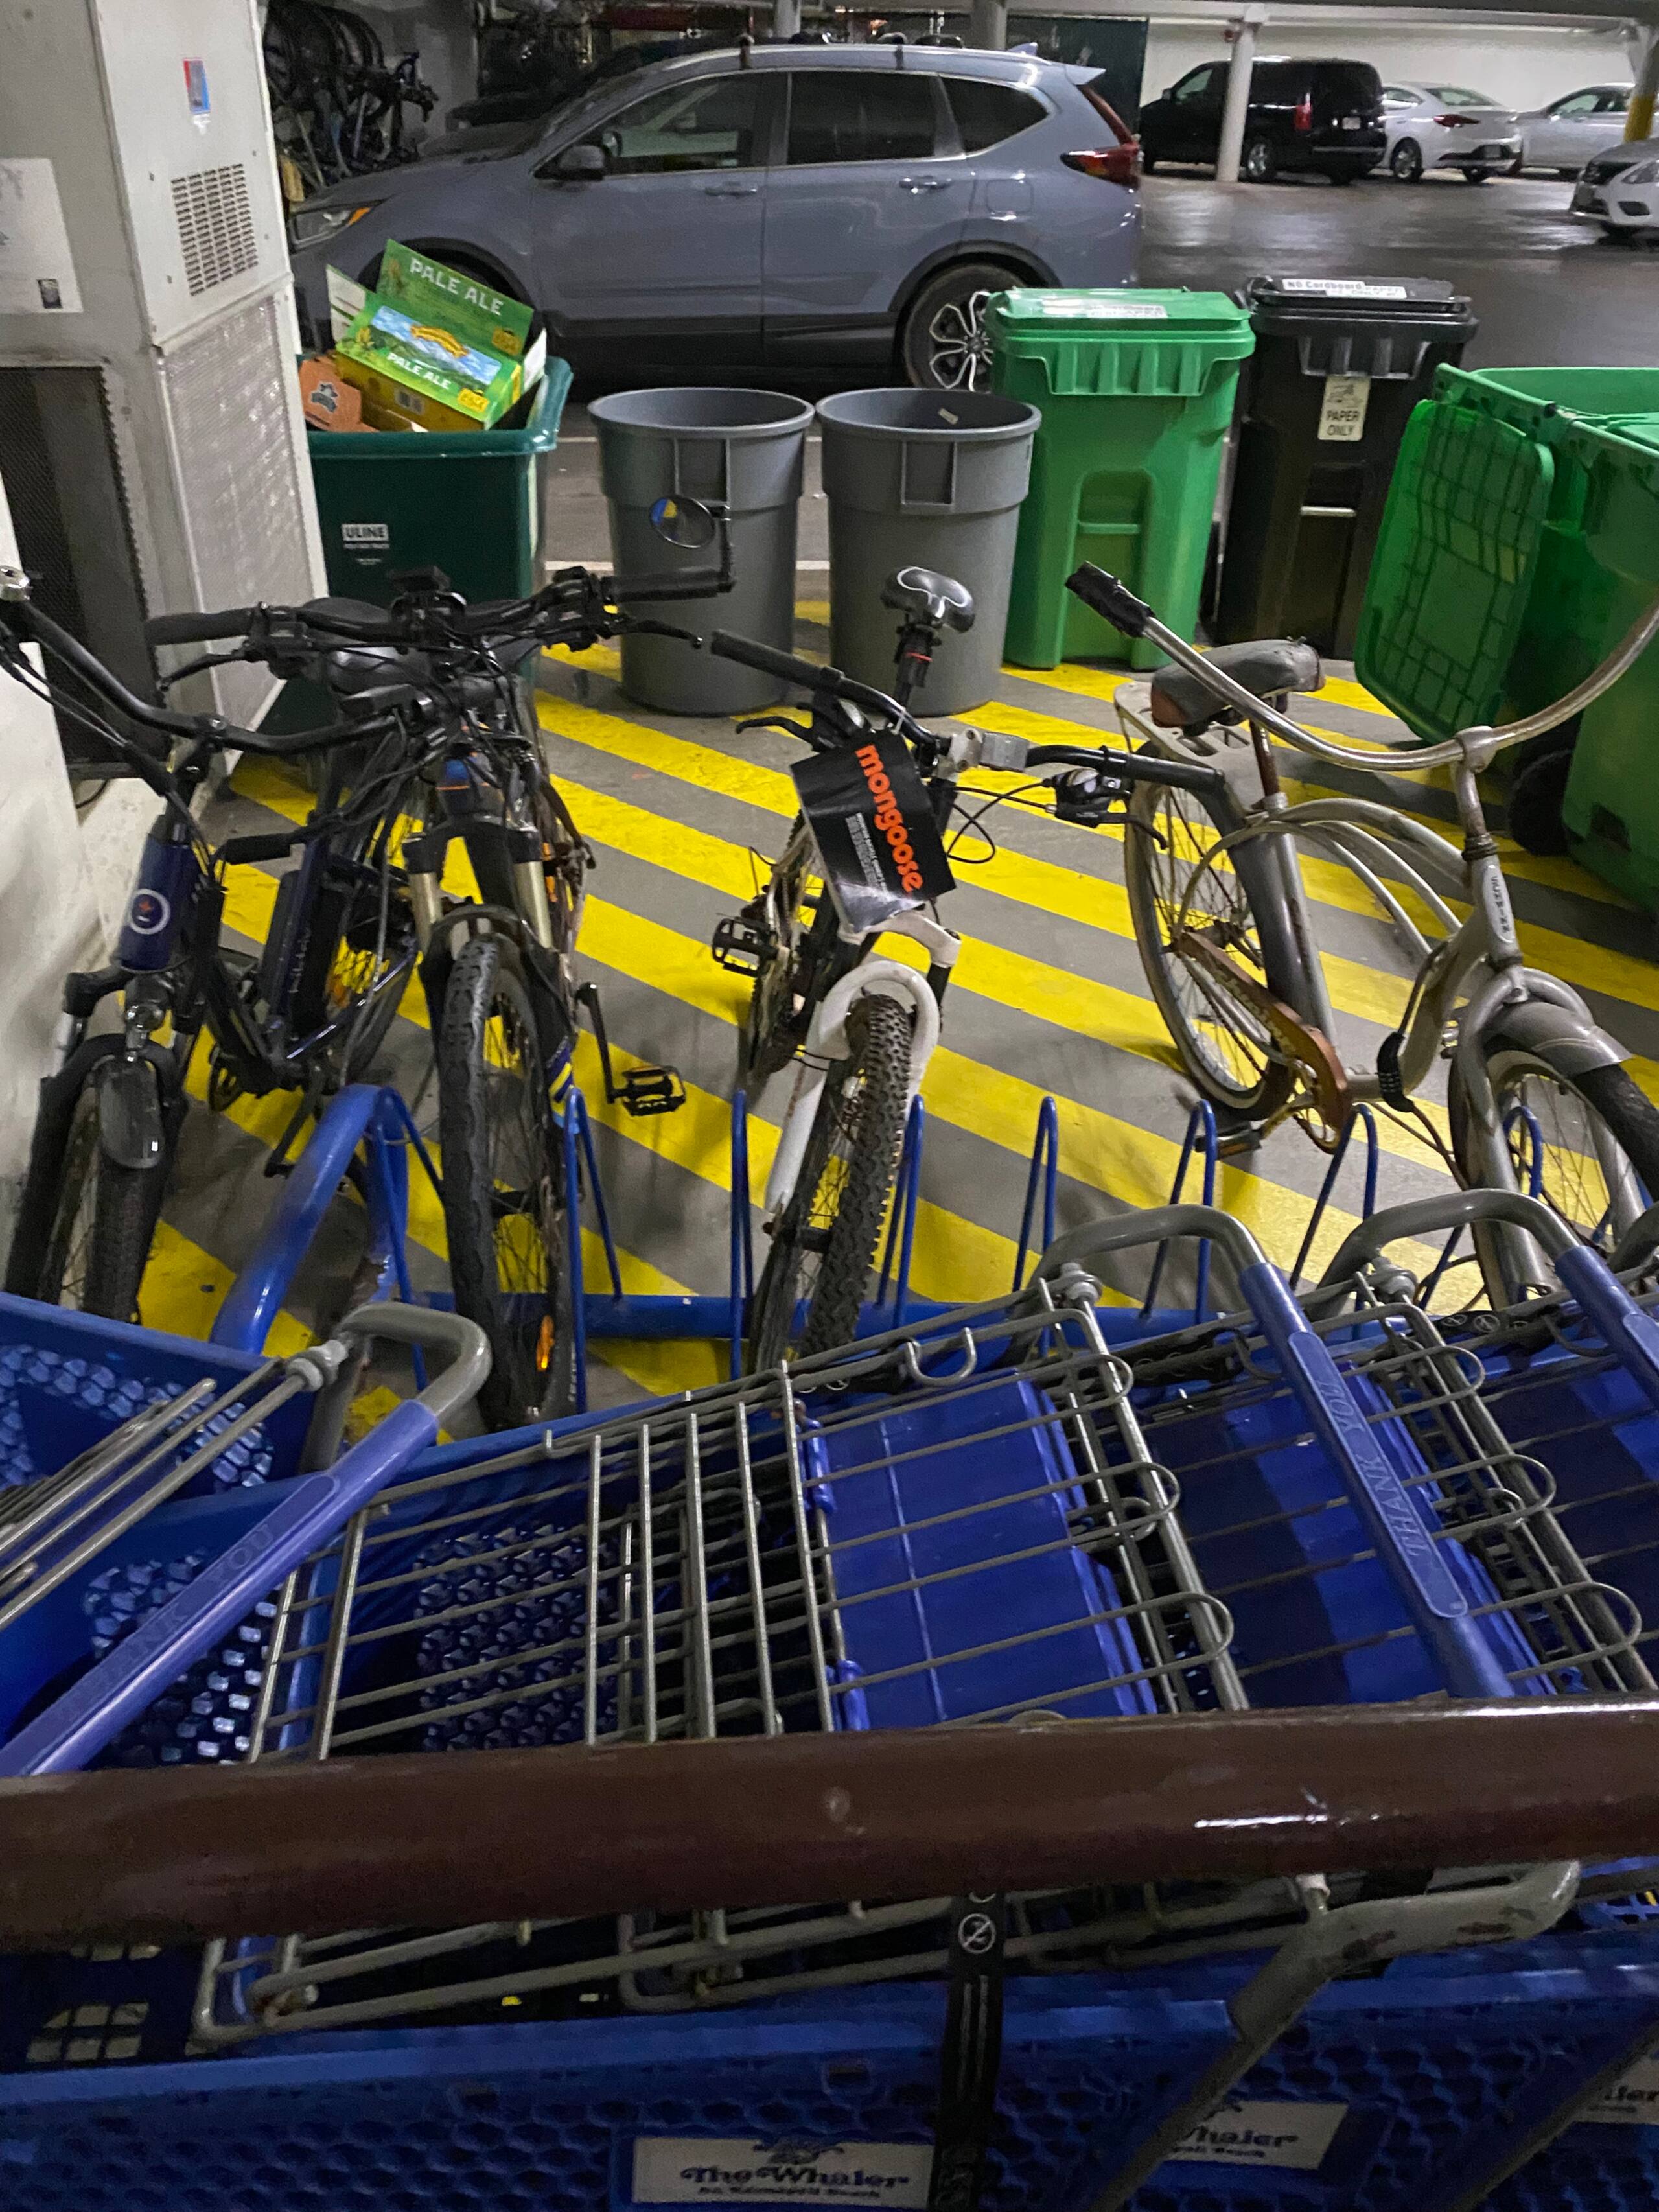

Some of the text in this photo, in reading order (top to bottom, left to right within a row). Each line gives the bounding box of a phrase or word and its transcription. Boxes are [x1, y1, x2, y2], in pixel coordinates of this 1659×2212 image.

[410, 257, 504, 316] PALE ALE
[386, 352, 452, 390] PALE ALE
[1326, 410, 1360, 421] PAPER
[1327, 425, 1355, 436] ONLY
[345, 526, 384, 539] ULINE
[855, 743, 924, 893] mongoose
[1316, 1380, 1432, 1558] THANK YOU
[209, 1523, 275, 1585] YOU
[680, 2164, 910, 2187] The Whaler
